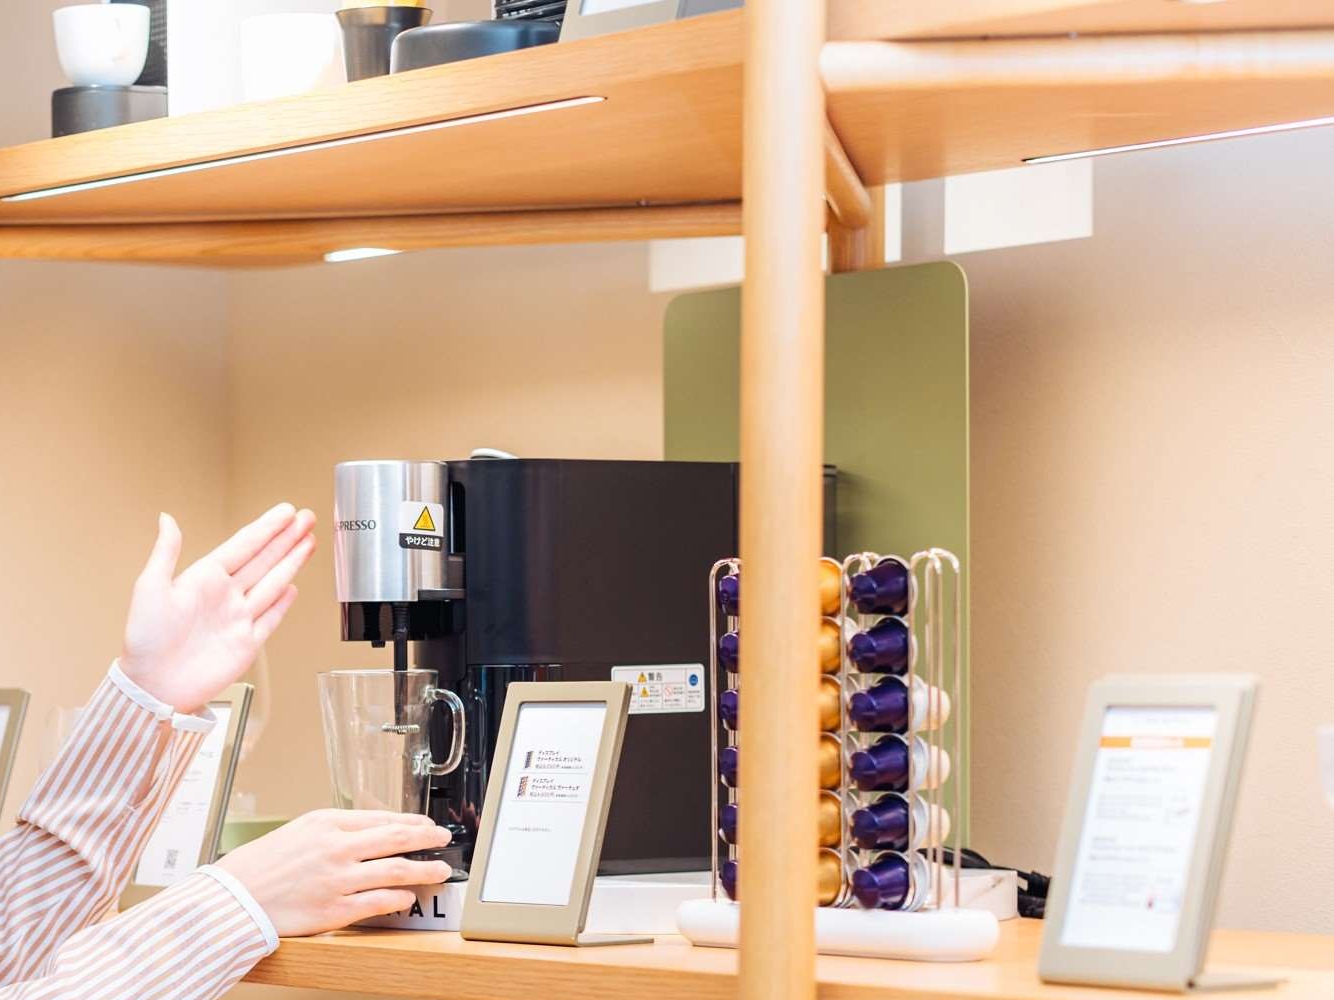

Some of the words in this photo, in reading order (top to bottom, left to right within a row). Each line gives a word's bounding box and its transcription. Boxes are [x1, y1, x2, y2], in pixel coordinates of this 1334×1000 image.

[405, 536, 441, 548] やけど注意
